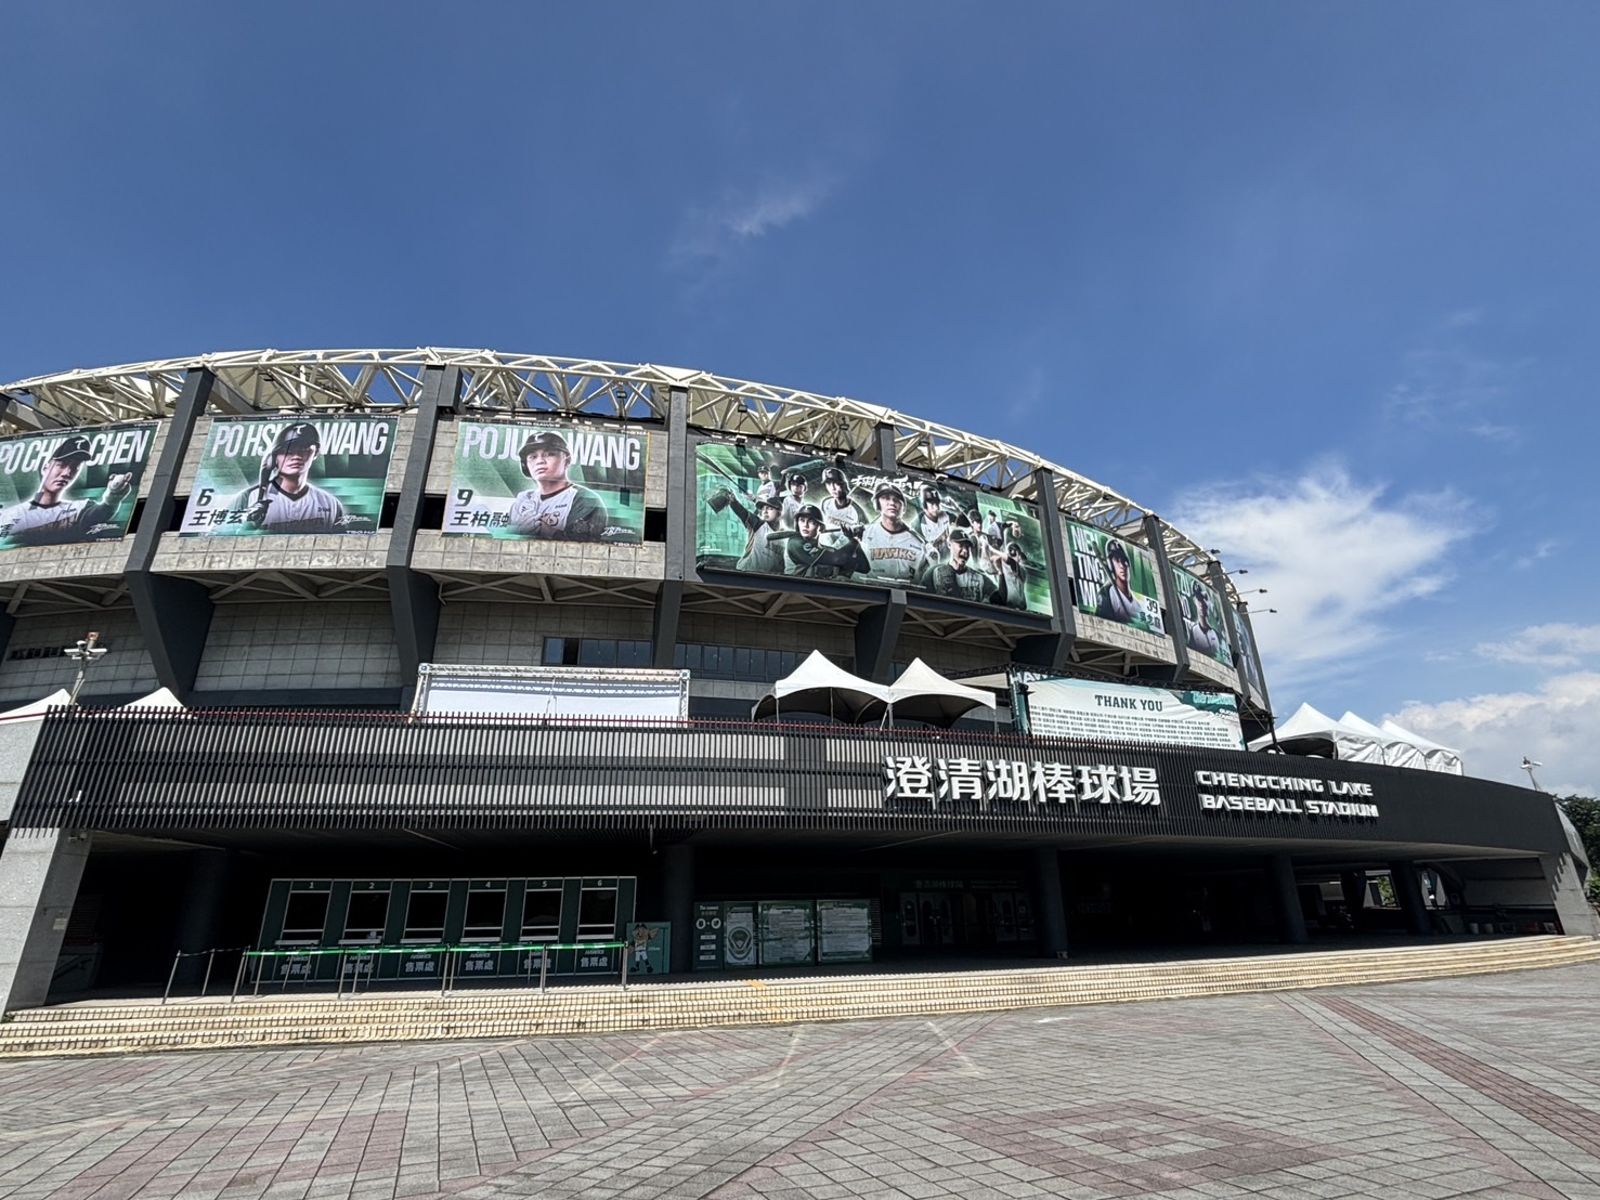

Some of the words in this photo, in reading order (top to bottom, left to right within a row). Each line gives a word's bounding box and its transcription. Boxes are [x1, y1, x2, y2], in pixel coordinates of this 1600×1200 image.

[85, 429, 151, 467] CHEN
[210, 424, 243, 458] PO
[320, 422, 390, 456] WANG
[461, 425, 498, 460] PO
[567, 431, 642, 472] WANG
[196, 488, 215, 506] 6
[455, 488, 474, 507] 9
[188, 509, 247, 527] 王博玄
[449, 510, 510, 528] 王柏融
[1094, 694, 1138, 710] THANK
[1140, 698, 1164, 712] YOU
[884, 755, 1162, 806] 澄清湖棒球場
[1196, 770, 1325, 793] CHENGCHING
[1328, 779, 1374, 797] LAKE
[1200, 794, 1303, 813] BASEBALL
[1306, 799, 1380, 818] STADIUM
